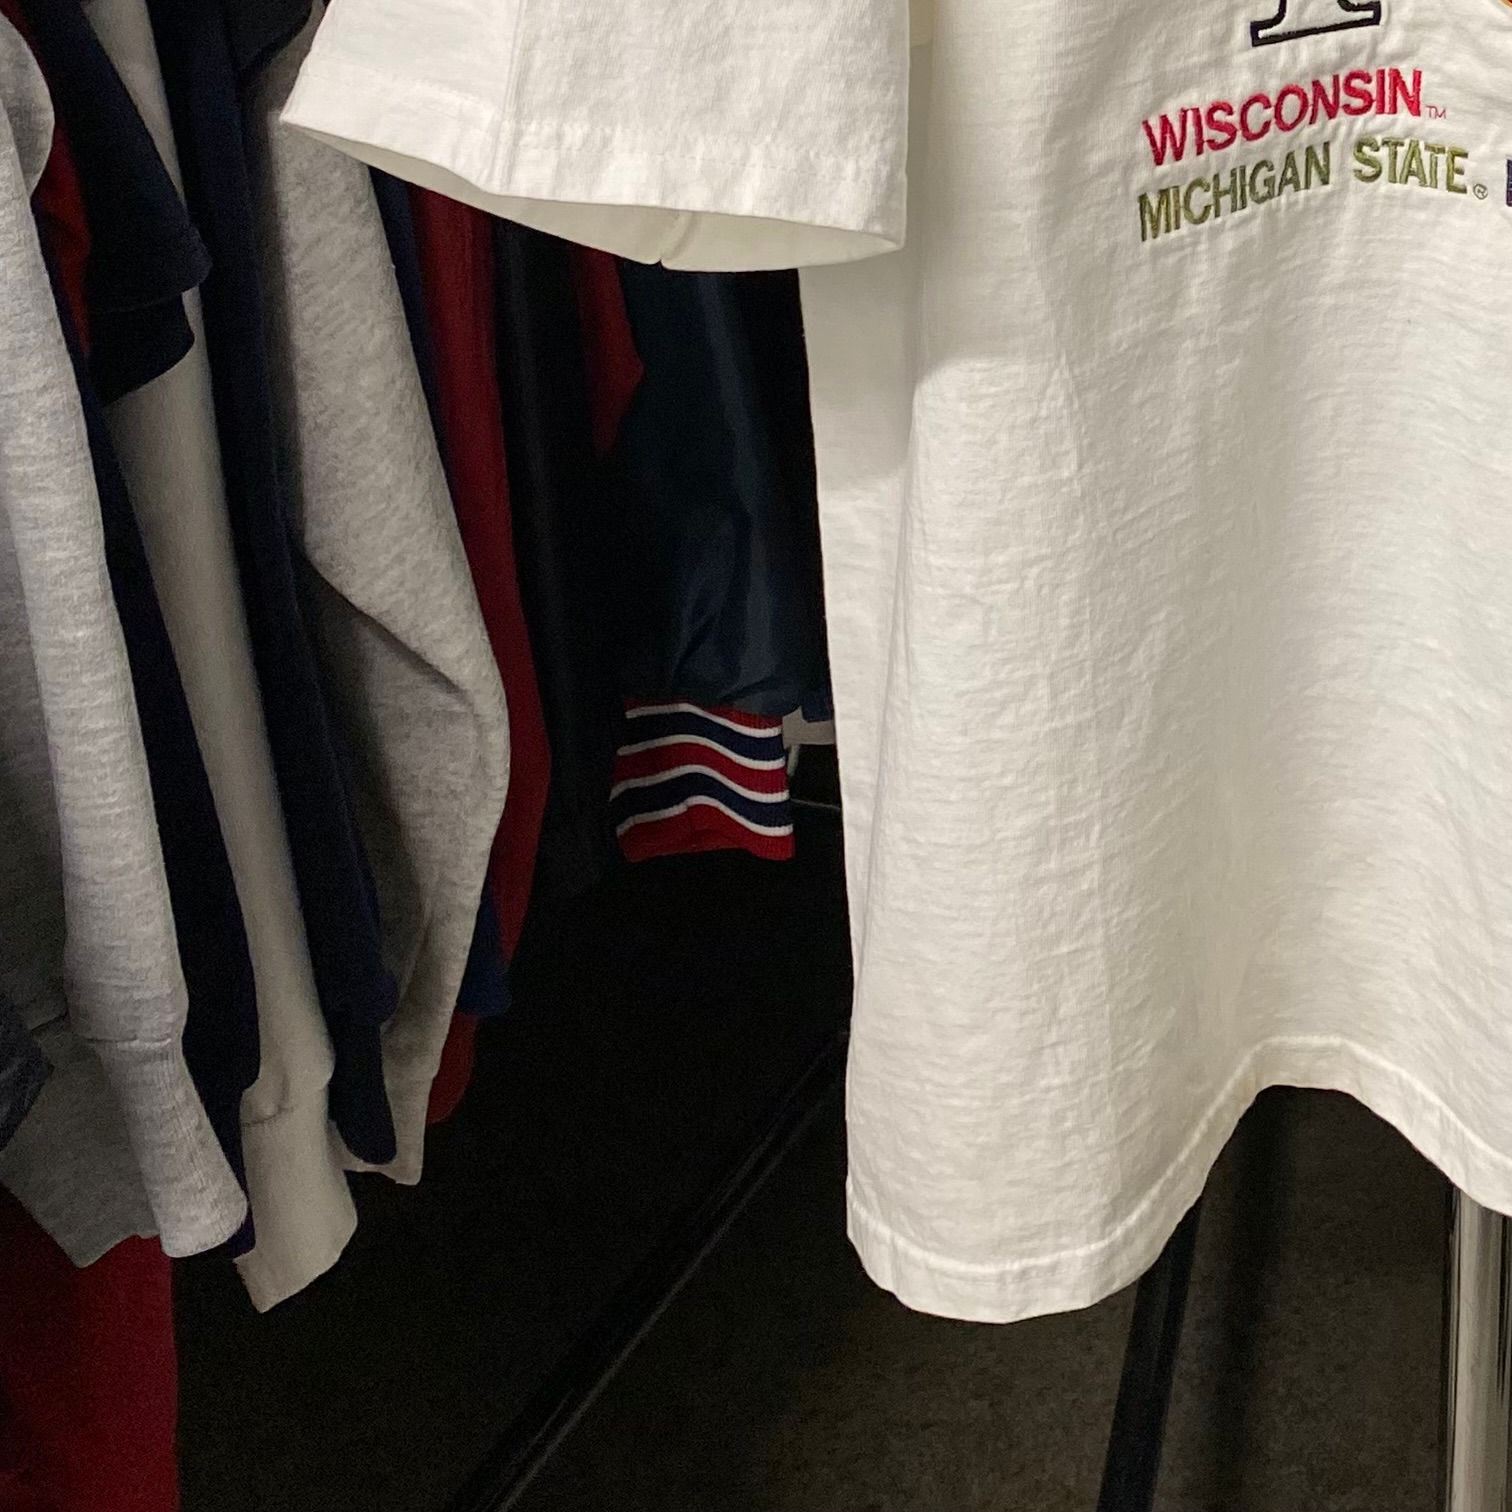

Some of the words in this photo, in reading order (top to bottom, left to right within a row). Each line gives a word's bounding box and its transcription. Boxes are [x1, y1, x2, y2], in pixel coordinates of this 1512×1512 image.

[1142, 67, 1422, 167] WISCONSIN
[1138, 142, 1331, 243] MICHIGAN
[1353, 136, 1469, 194] STATE
